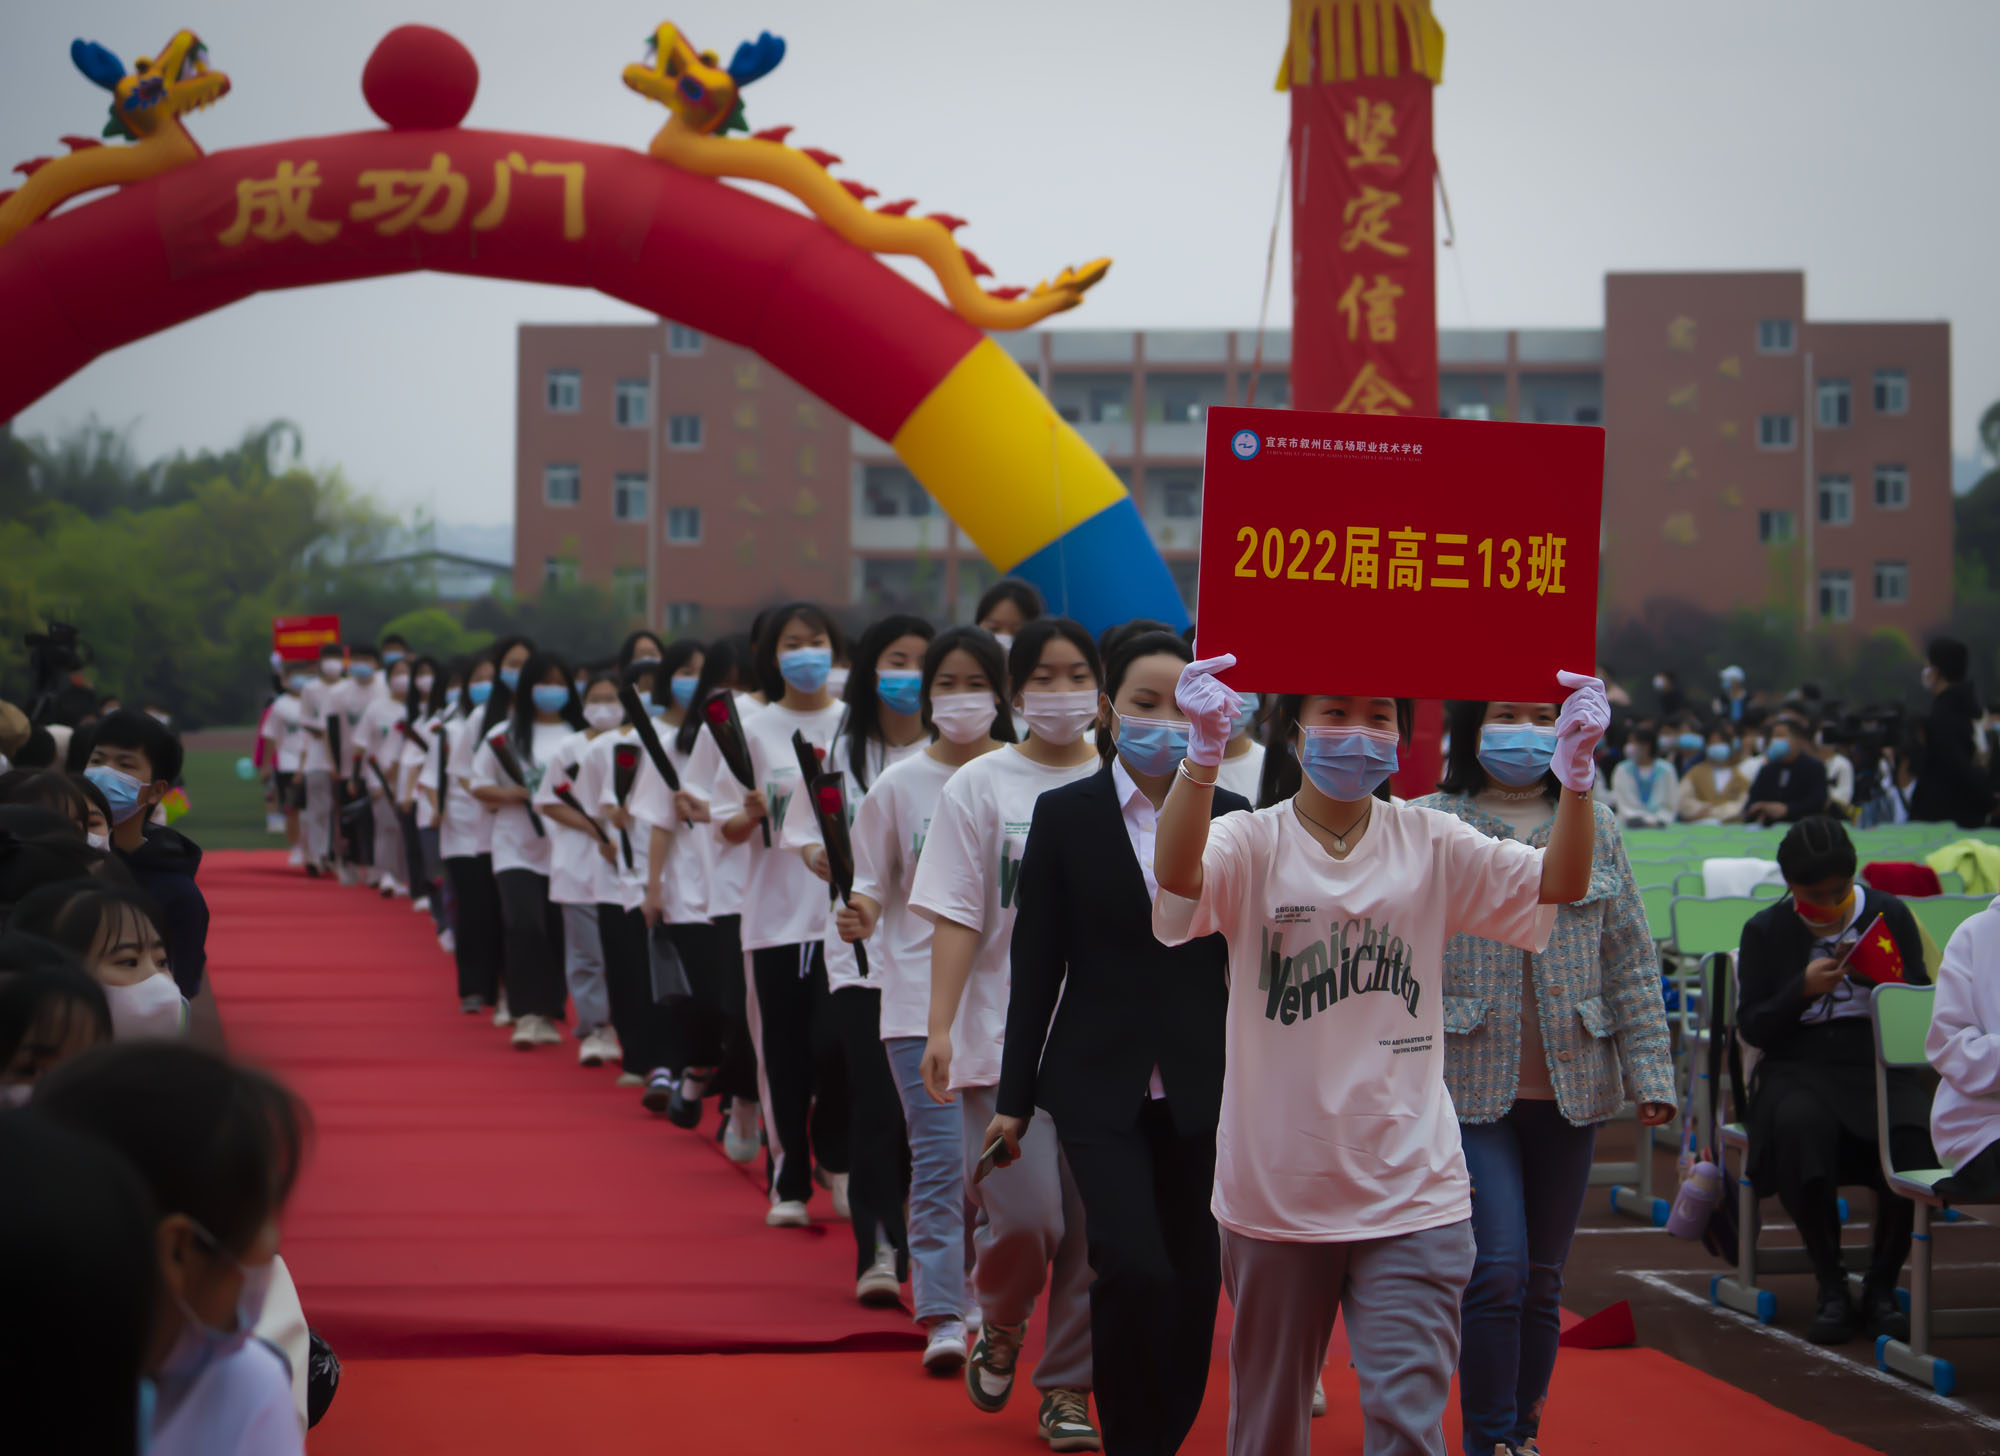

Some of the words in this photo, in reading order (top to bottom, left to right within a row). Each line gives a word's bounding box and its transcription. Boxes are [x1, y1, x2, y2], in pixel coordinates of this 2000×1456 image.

[218, 152, 585, 246] 成功门
[1265, 436, 1423, 454] 宜宾市叙州区高场职业技术学校
[1234, 525, 1567, 596] 2022届高三13班
